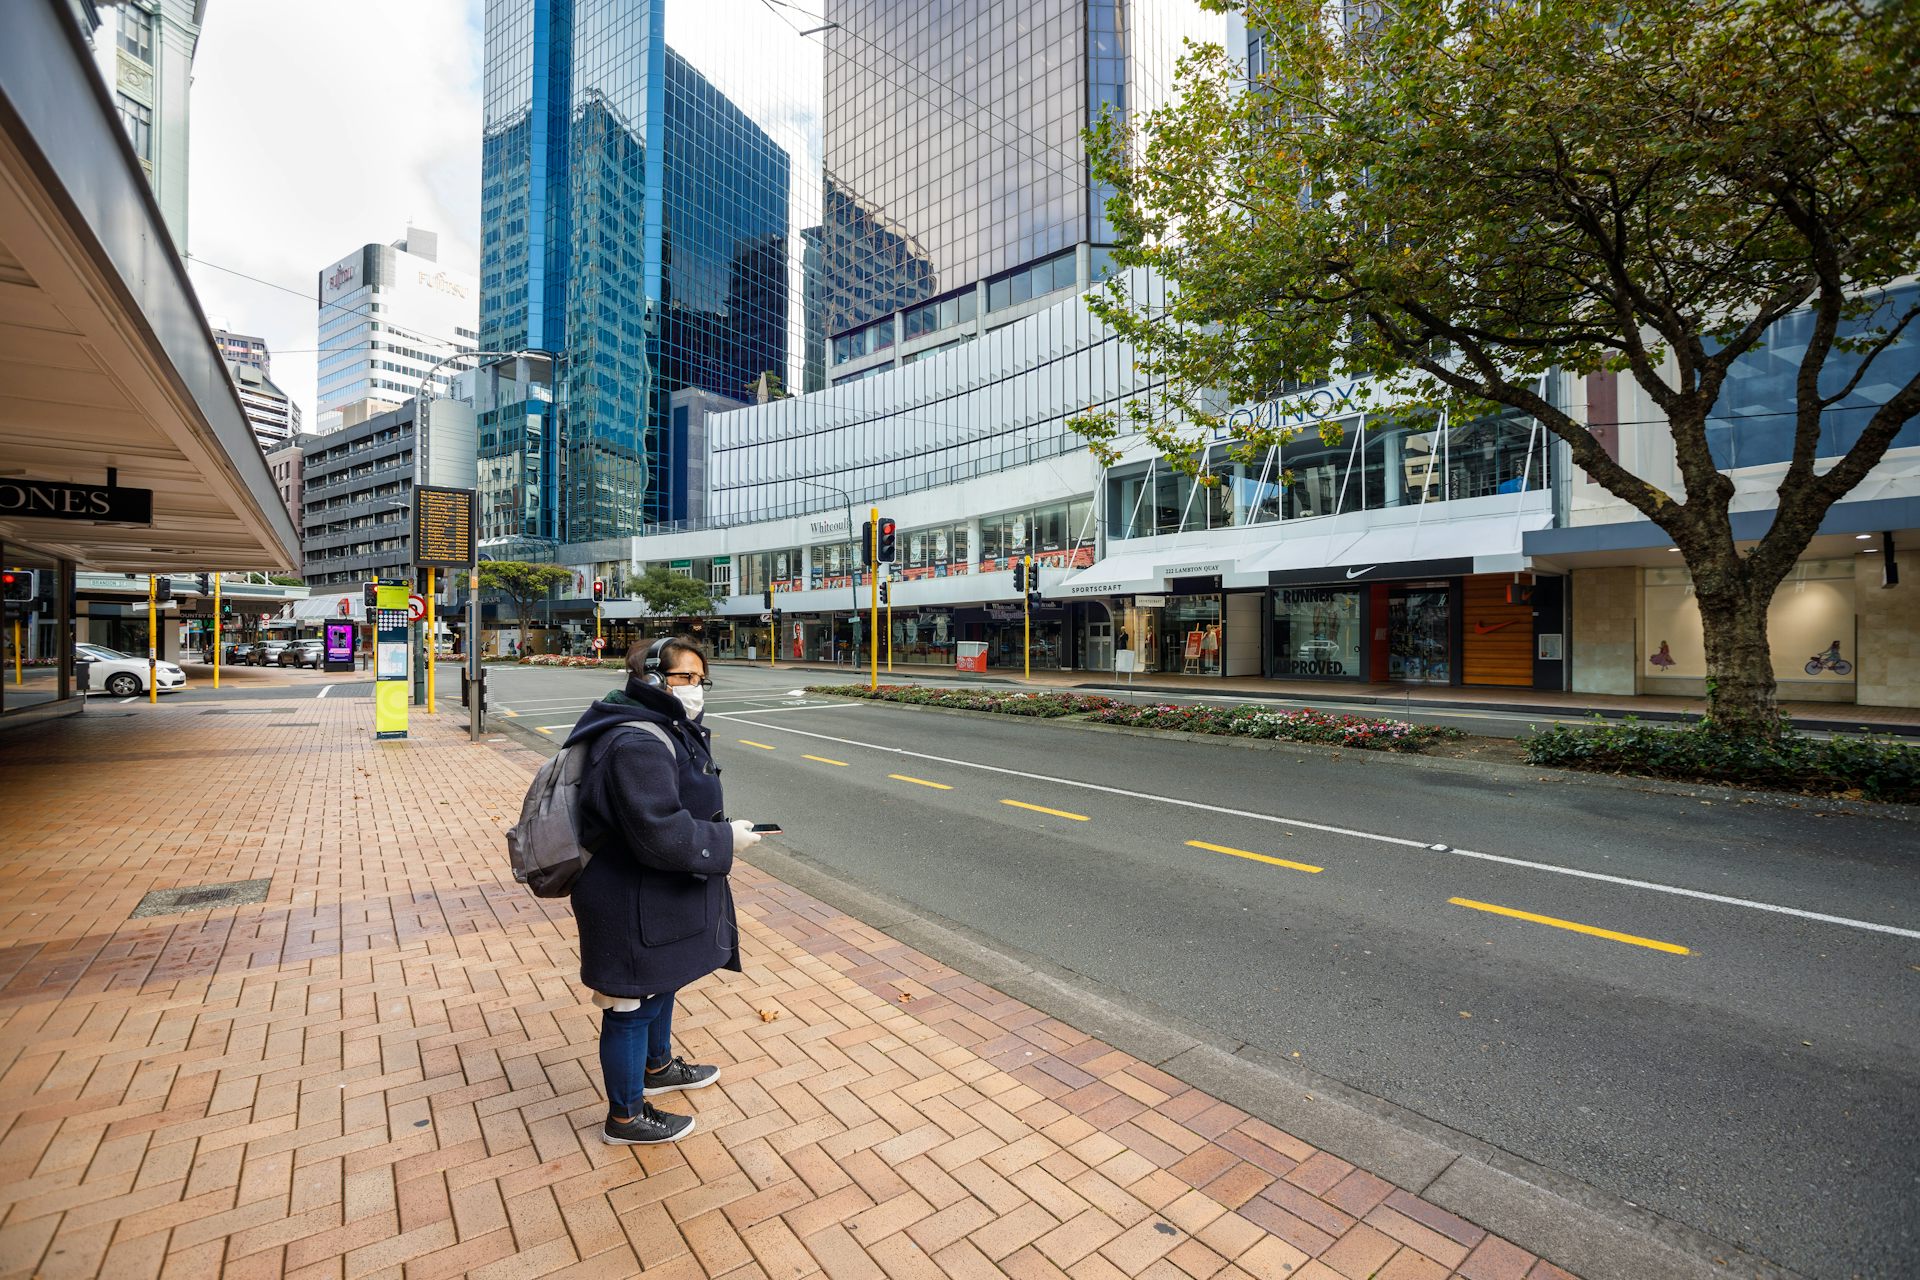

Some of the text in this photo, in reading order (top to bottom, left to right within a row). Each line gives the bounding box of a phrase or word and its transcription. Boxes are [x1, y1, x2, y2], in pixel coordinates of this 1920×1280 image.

[1175, 565, 1203, 574] LAMBTON
[1072, 584, 1122, 593] SPORTSCRAFT
[1283, 590, 1335, 603] RUNNER
